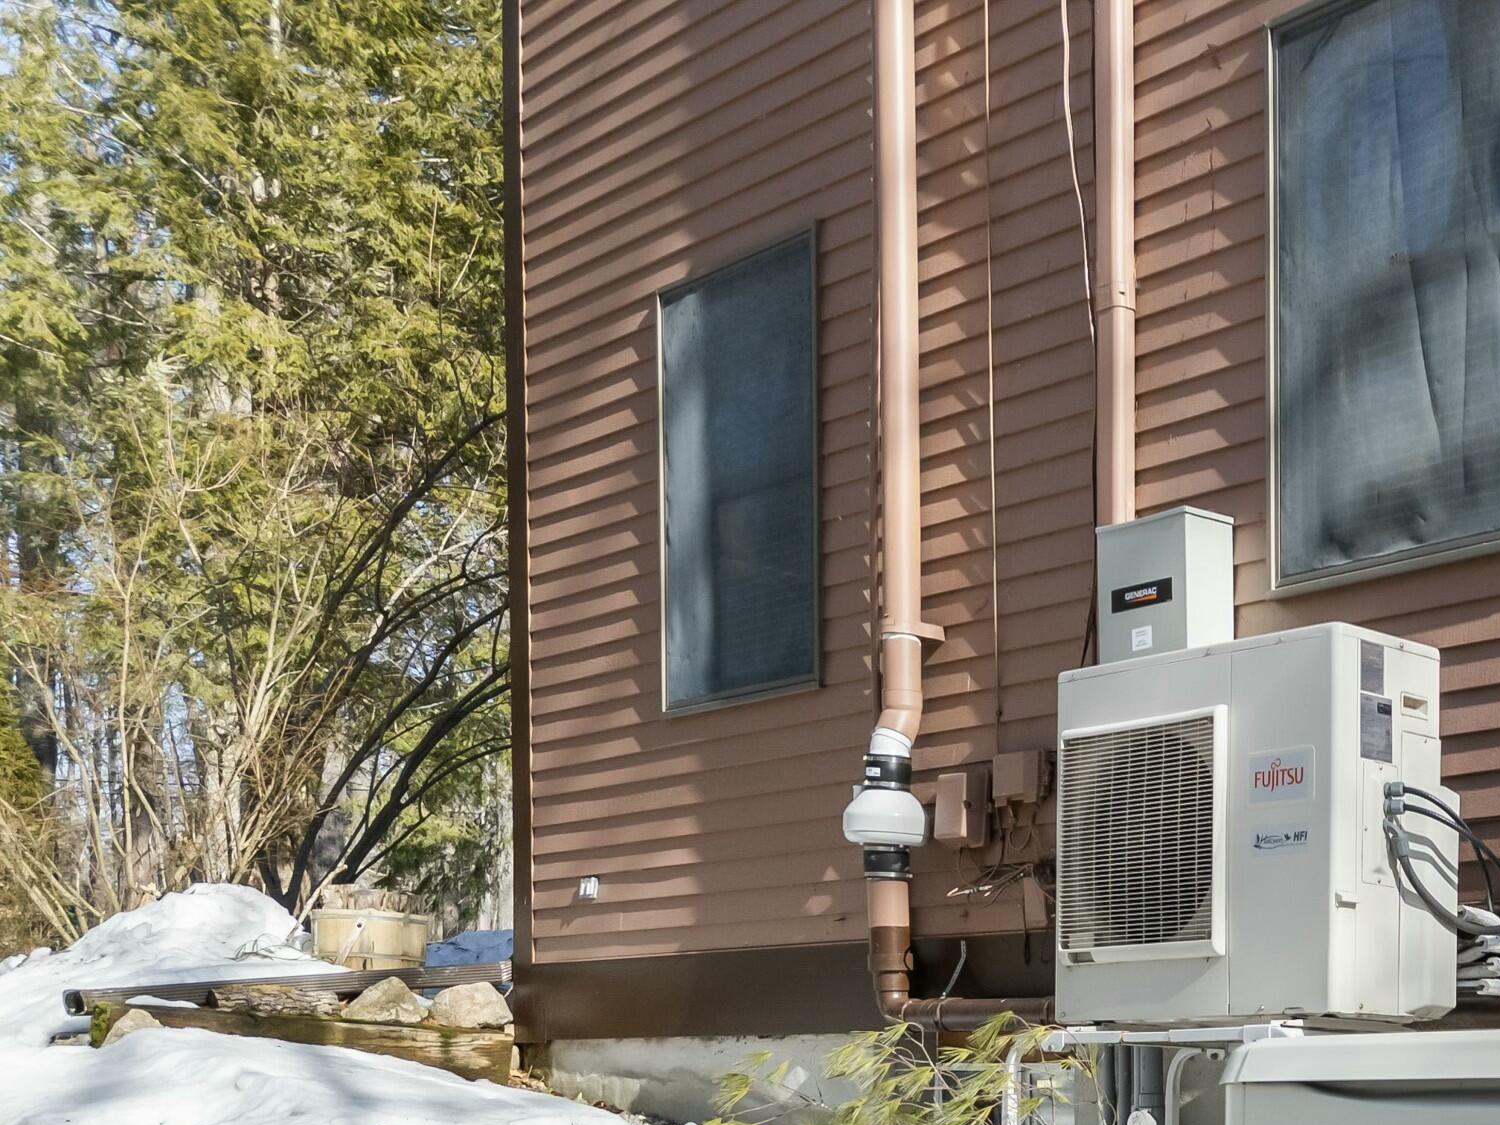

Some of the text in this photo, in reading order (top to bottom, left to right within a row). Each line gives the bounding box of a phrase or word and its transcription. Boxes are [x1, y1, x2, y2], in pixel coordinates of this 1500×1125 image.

[1124, 586, 1157, 600] GENERAC
[1254, 759, 1304, 792] FUJITSU
[1293, 830, 1308, 842] HFI
